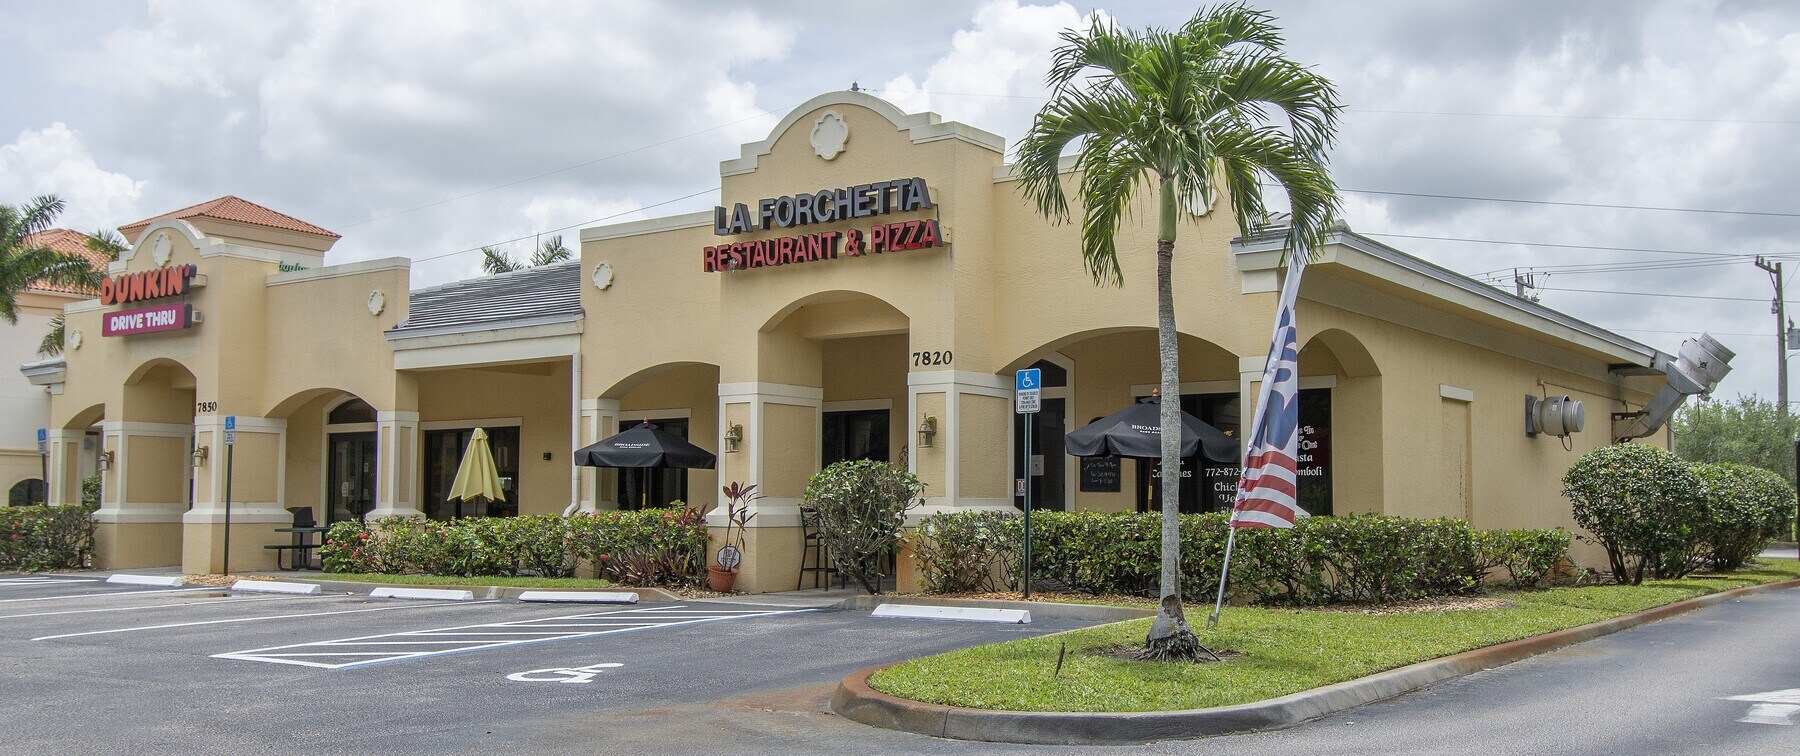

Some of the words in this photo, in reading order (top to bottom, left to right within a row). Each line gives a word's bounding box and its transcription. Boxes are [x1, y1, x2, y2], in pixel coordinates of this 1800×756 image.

[714, 202, 752, 235] LA
[758, 176, 931, 230] FORCHETTA
[703, 230, 841, 272] RESTAURANT
[844, 228, 864, 257] &
[870, 219, 943, 254] PIZZA
[100, 263, 192, 305] DUNKIN'
[110, 313, 144, 331] DRIVE
[145, 309, 176, 328] THRU
[912, 350, 953, 367] 7820
[197, 401, 218, 413] 7850
[1297, 453, 1313, 462] sta
[1297, 466, 1322, 476] mboli
